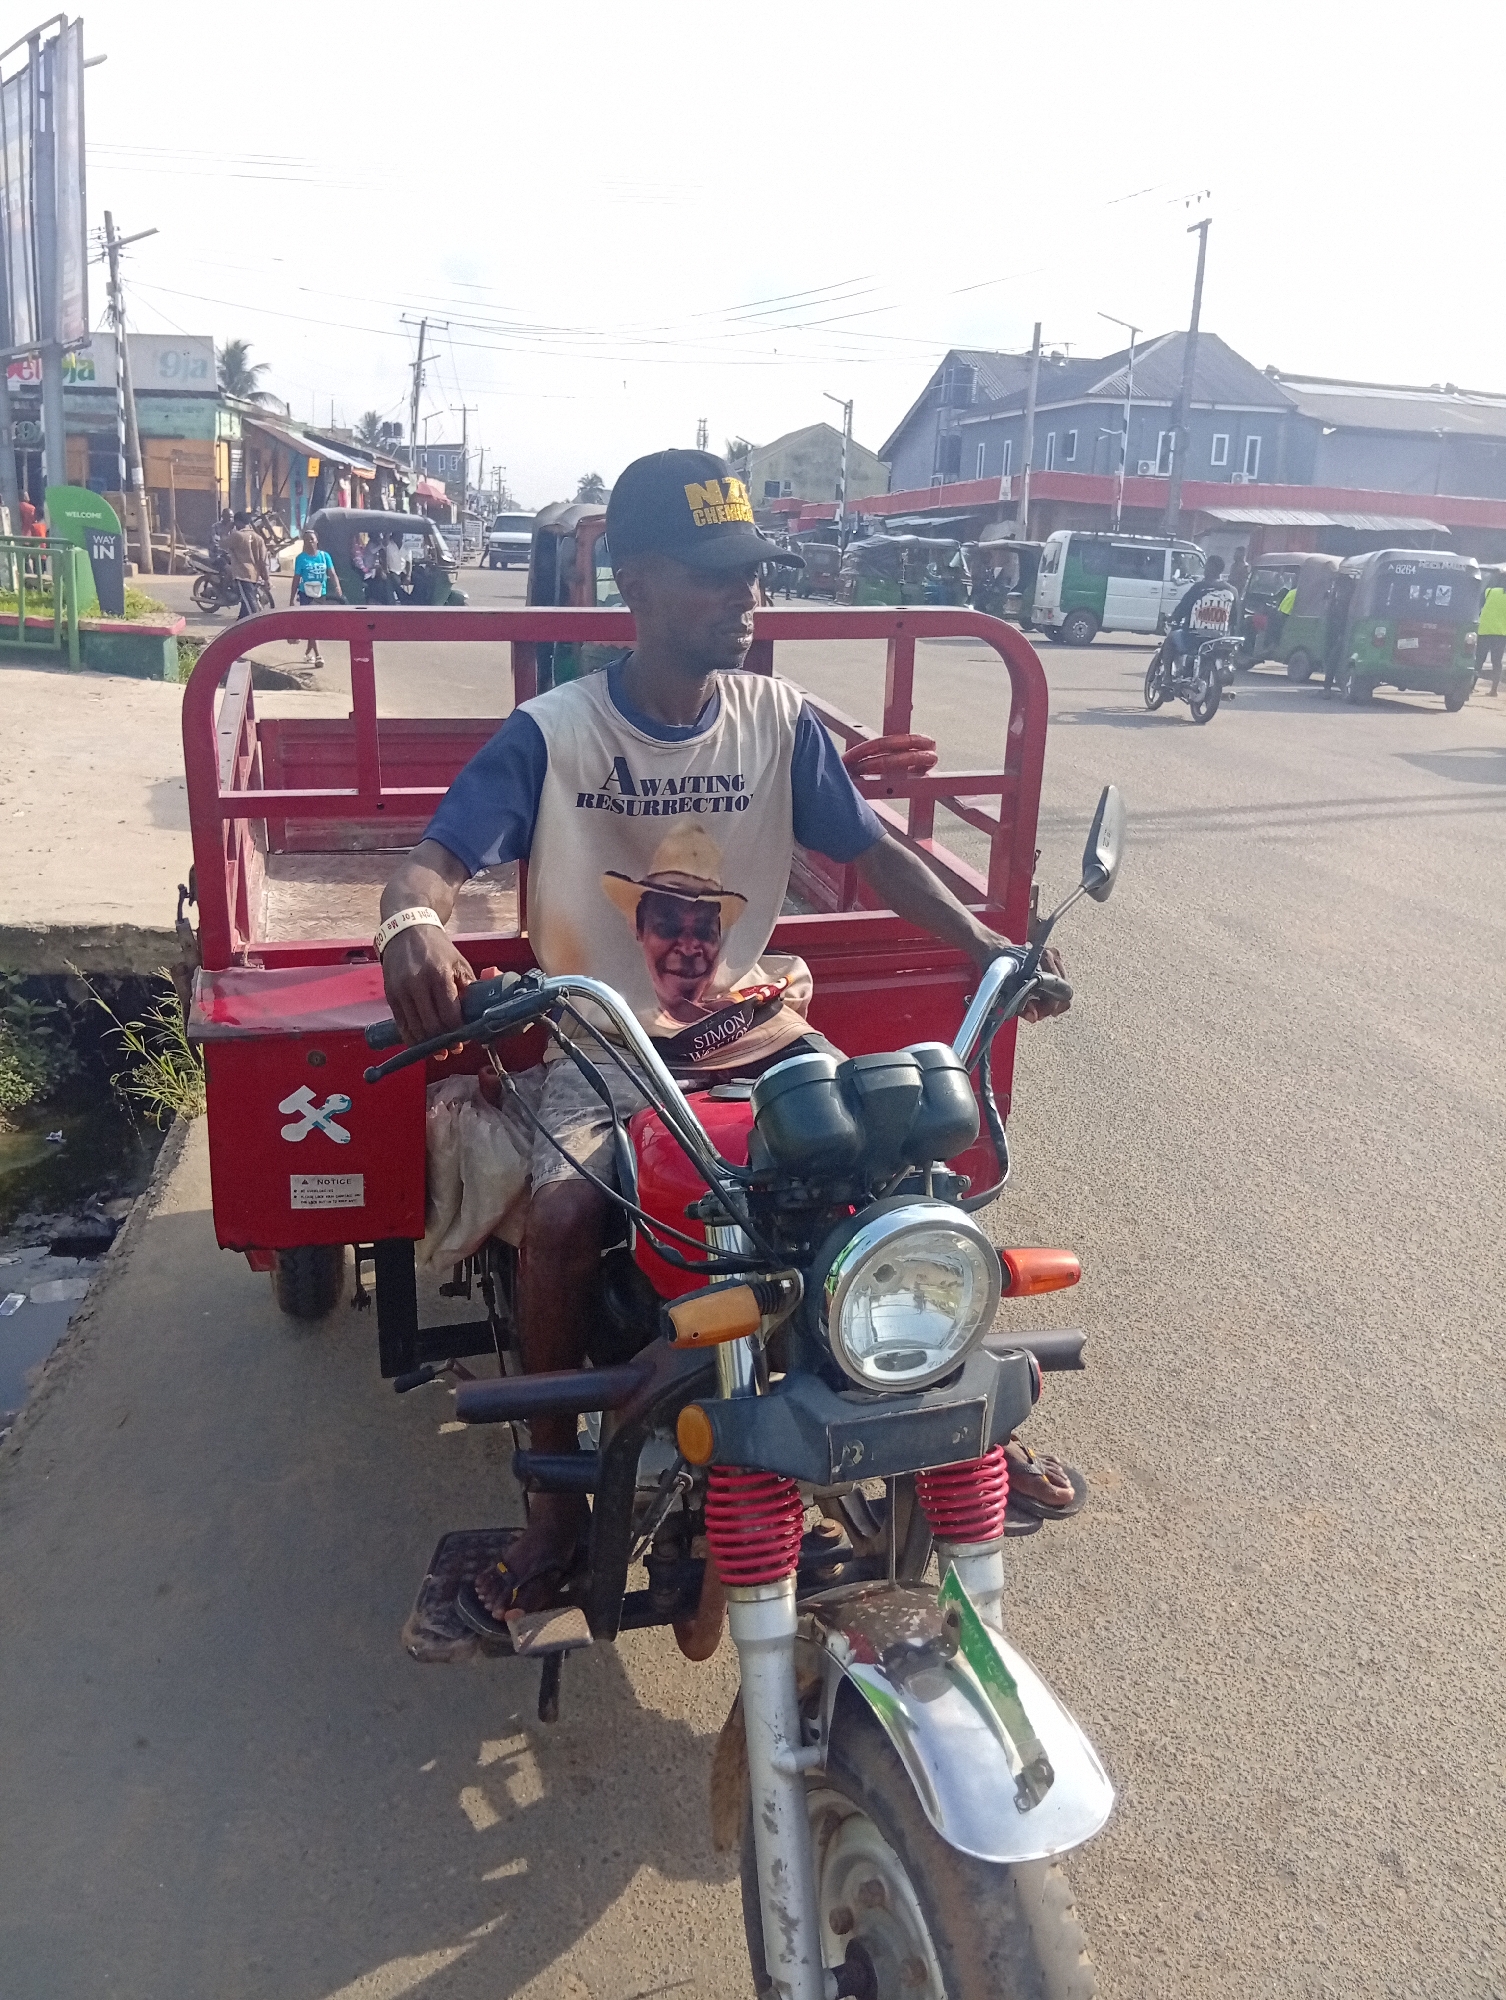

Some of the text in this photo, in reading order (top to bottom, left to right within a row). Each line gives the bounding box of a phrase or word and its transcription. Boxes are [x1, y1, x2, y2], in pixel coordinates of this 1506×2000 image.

[93, 535, 116, 544] WAY
[93, 545, 115, 560] IN
[599, 756, 746, 797] AWAITING
[575, 792, 755, 817] RESURRECTIO
[401, 912, 416, 921] For
[386, 919, 399, 930] Me
[693, 1010, 746, 1049] SIMON
